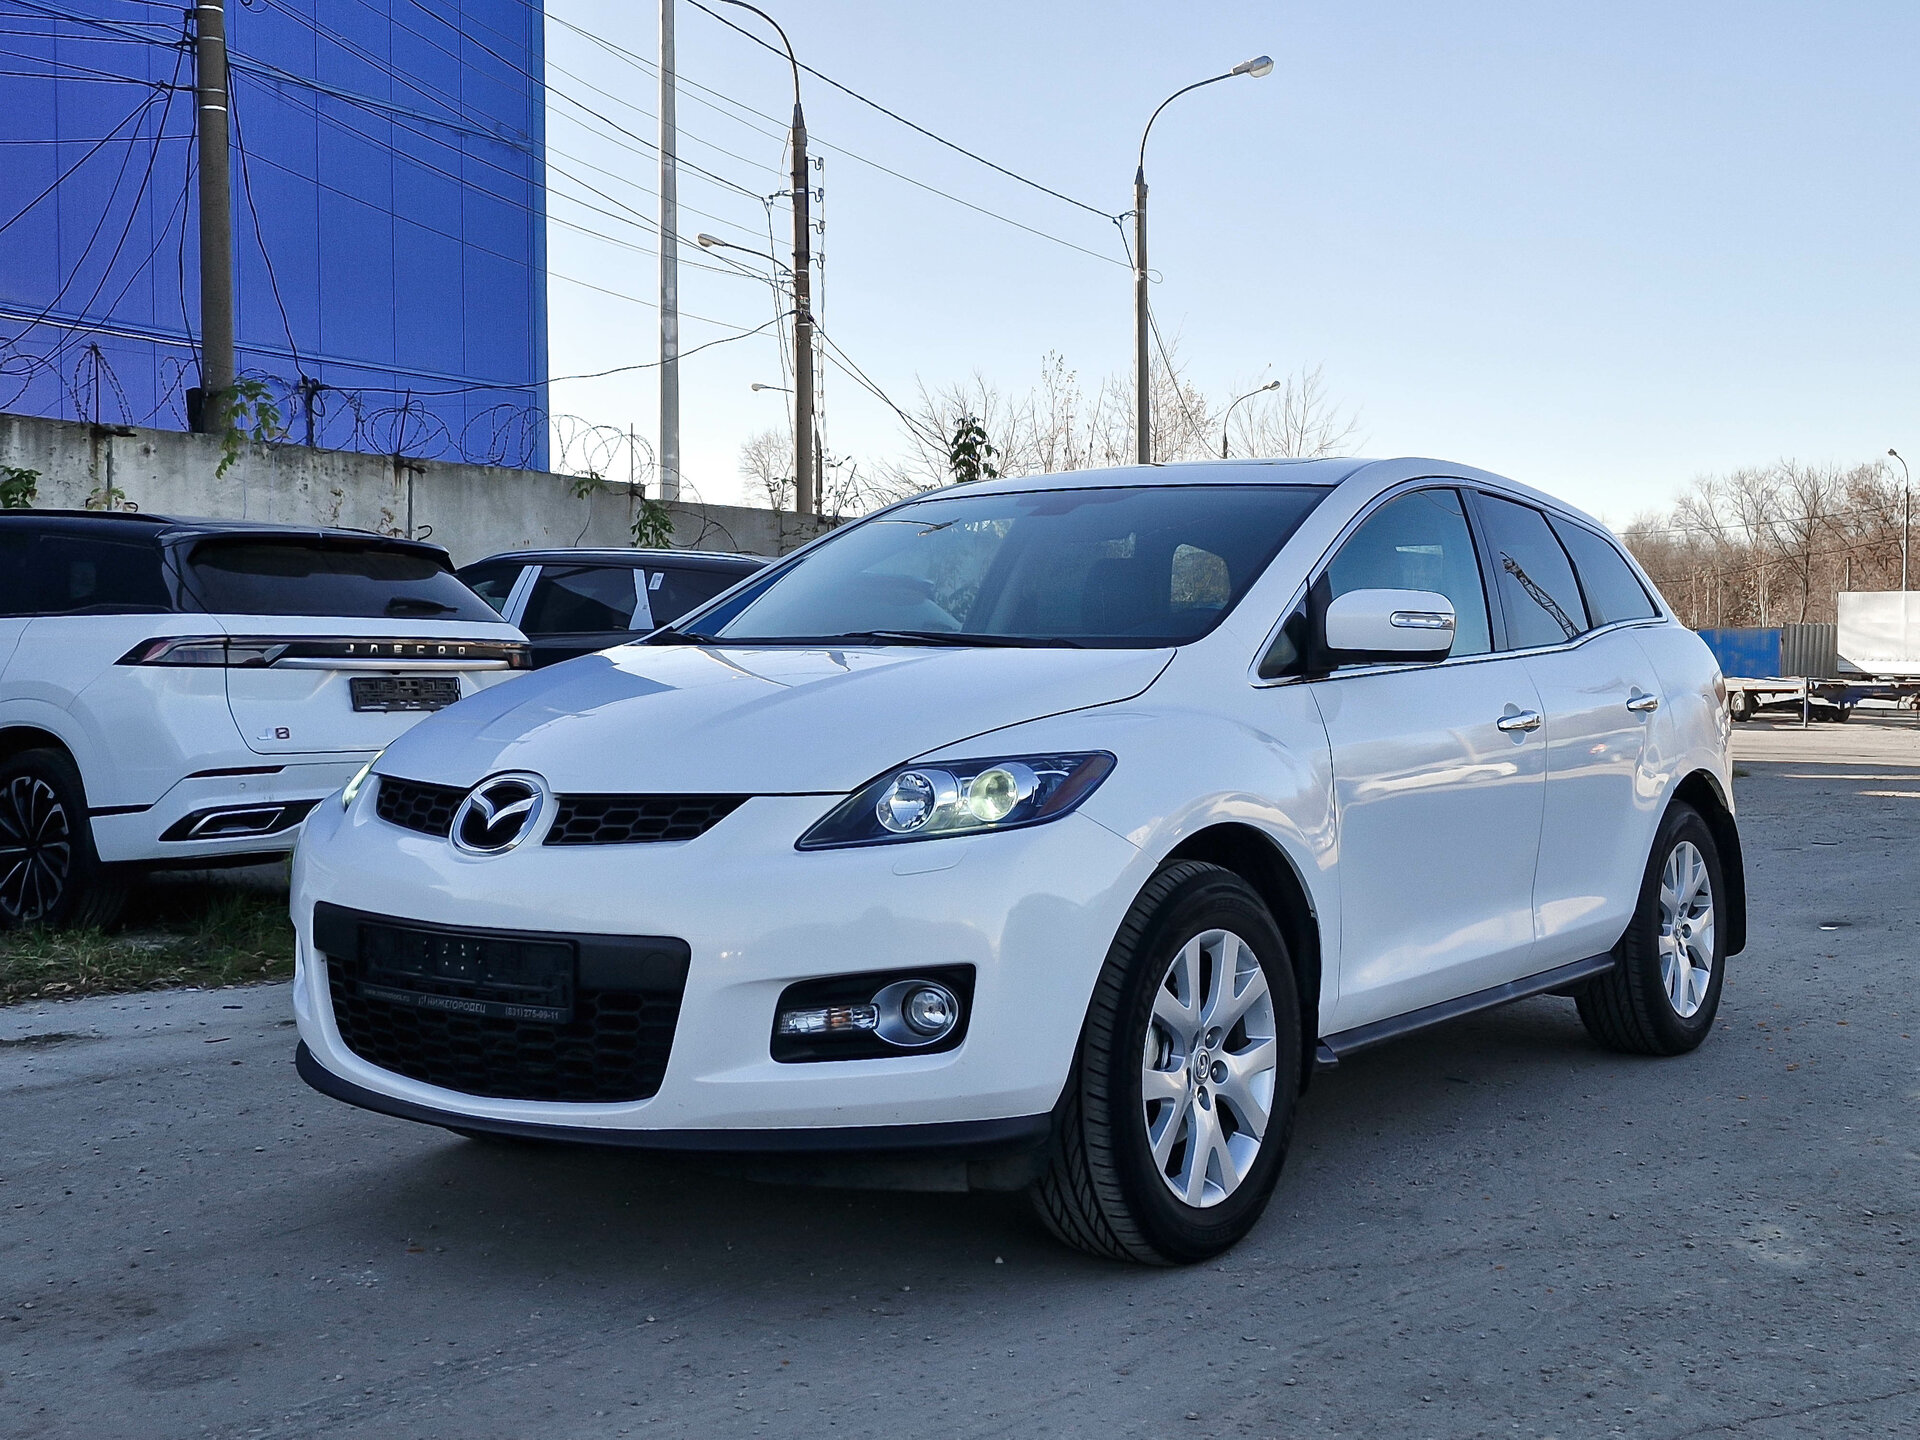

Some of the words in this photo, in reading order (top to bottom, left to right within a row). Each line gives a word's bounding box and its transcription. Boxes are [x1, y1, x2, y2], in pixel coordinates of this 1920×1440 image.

[345, 643, 466, 655] JAECOO
[256, 726, 290, 740] J8
[427, 996, 486, 1014] НИЖЕГОРОДЕЦ
